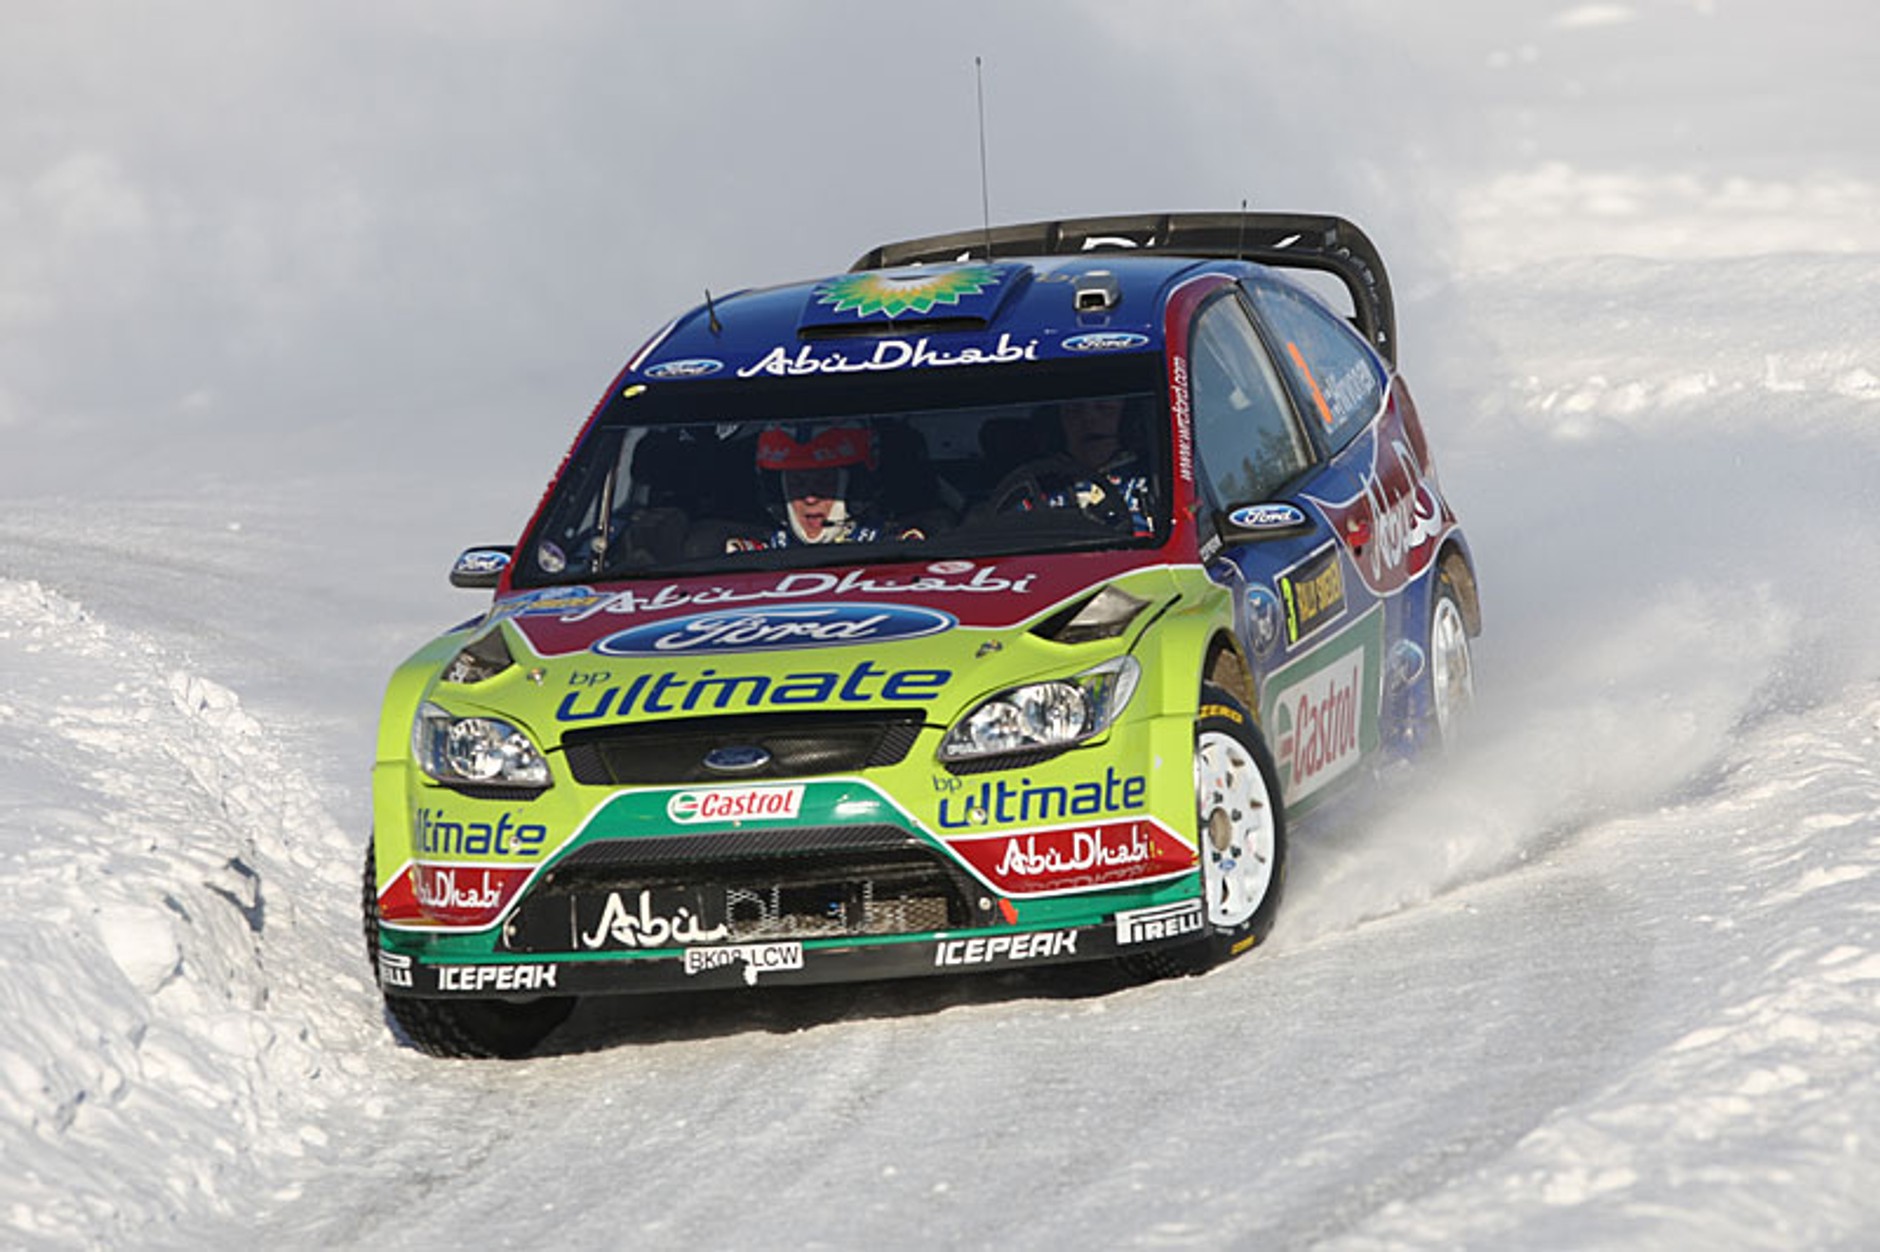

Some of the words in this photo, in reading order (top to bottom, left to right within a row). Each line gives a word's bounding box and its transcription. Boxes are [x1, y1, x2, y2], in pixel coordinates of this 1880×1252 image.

[1243, 508, 1293, 526] Ford
[655, 607, 890, 650] Ford
[555, 660, 953, 721] ultimate
[568, 671, 612, 687] bp
[1293, 664, 1358, 785] Castrol
[932, 776, 962, 793] bp
[938, 766, 1146, 829] ultimate
[701, 789, 794, 818] Castrol
[1114, 898, 1203, 946] PIRELLI
[751, 946, 799, 967] LCW
[934, 929, 1079, 967] ICEPEAK
[437, 964, 557, 990] ICEPEAK
